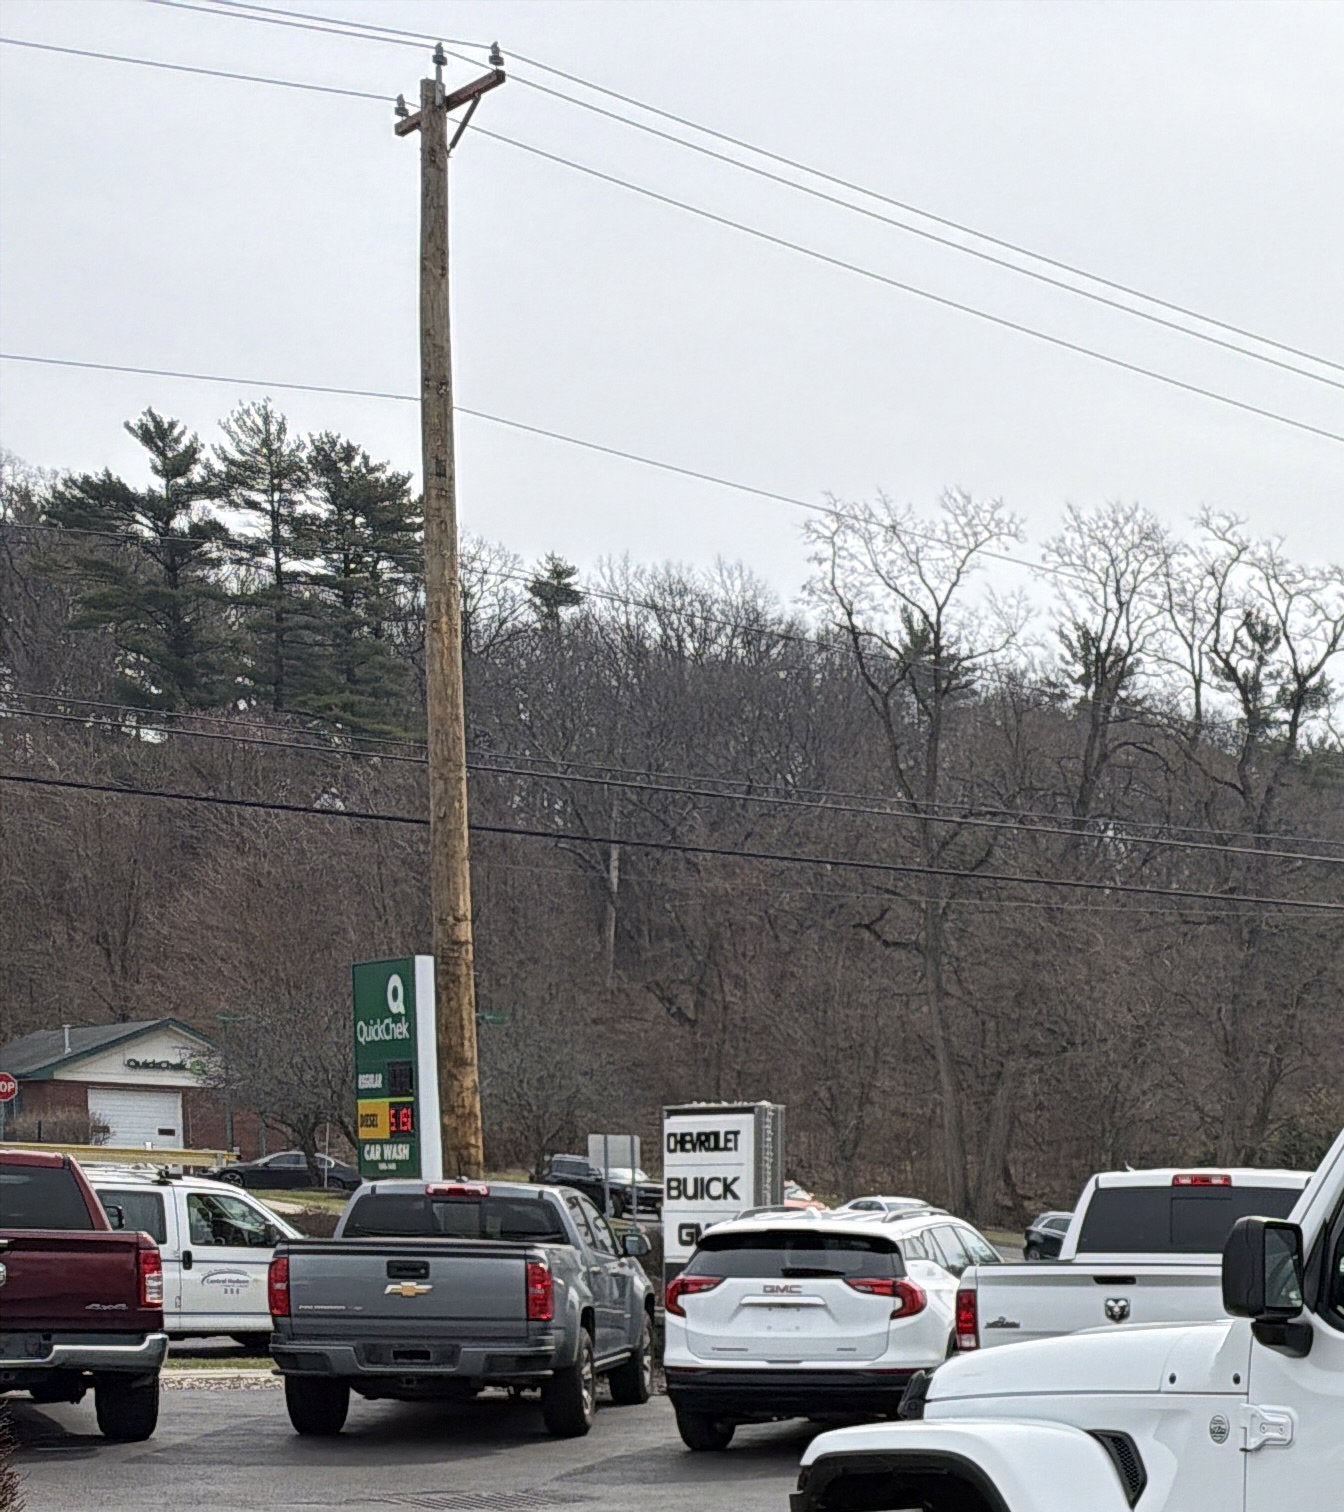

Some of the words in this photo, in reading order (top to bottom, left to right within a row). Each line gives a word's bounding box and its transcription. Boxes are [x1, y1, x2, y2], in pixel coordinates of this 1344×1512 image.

[357, 1017, 410, 1045] QuickChek
[0, 1081, 15, 1092] OP
[667, 1130, 741, 1153] CHEVROLET
[364, 1143, 381, 1161] CAR
[383, 1143, 410, 1161] WASH
[667, 1176, 741, 1200] BUICK
[763, 1285, 803, 1293] GMC
